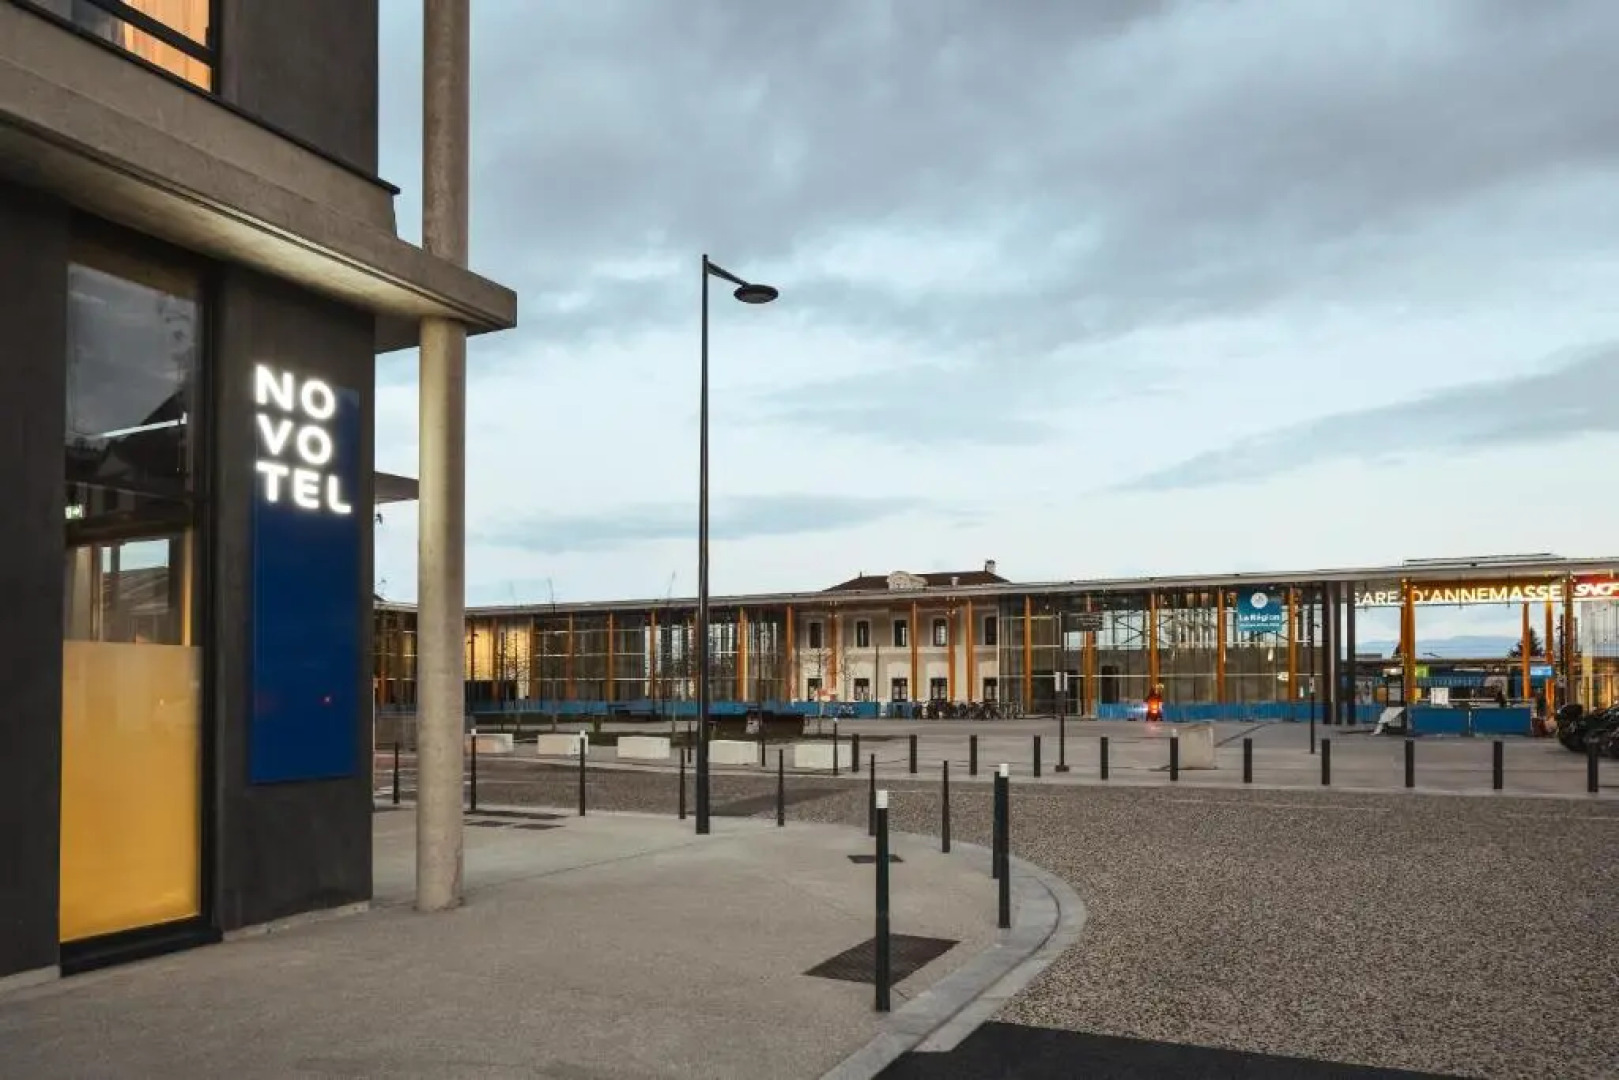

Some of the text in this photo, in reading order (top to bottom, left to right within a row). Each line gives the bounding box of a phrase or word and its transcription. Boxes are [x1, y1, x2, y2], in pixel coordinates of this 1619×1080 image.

[255, 364, 335, 419] NO
[256, 413, 332, 465] VO
[256, 460, 352, 514] TEL
[1411, 585, 1562, 604] D'ANNEMASSE
